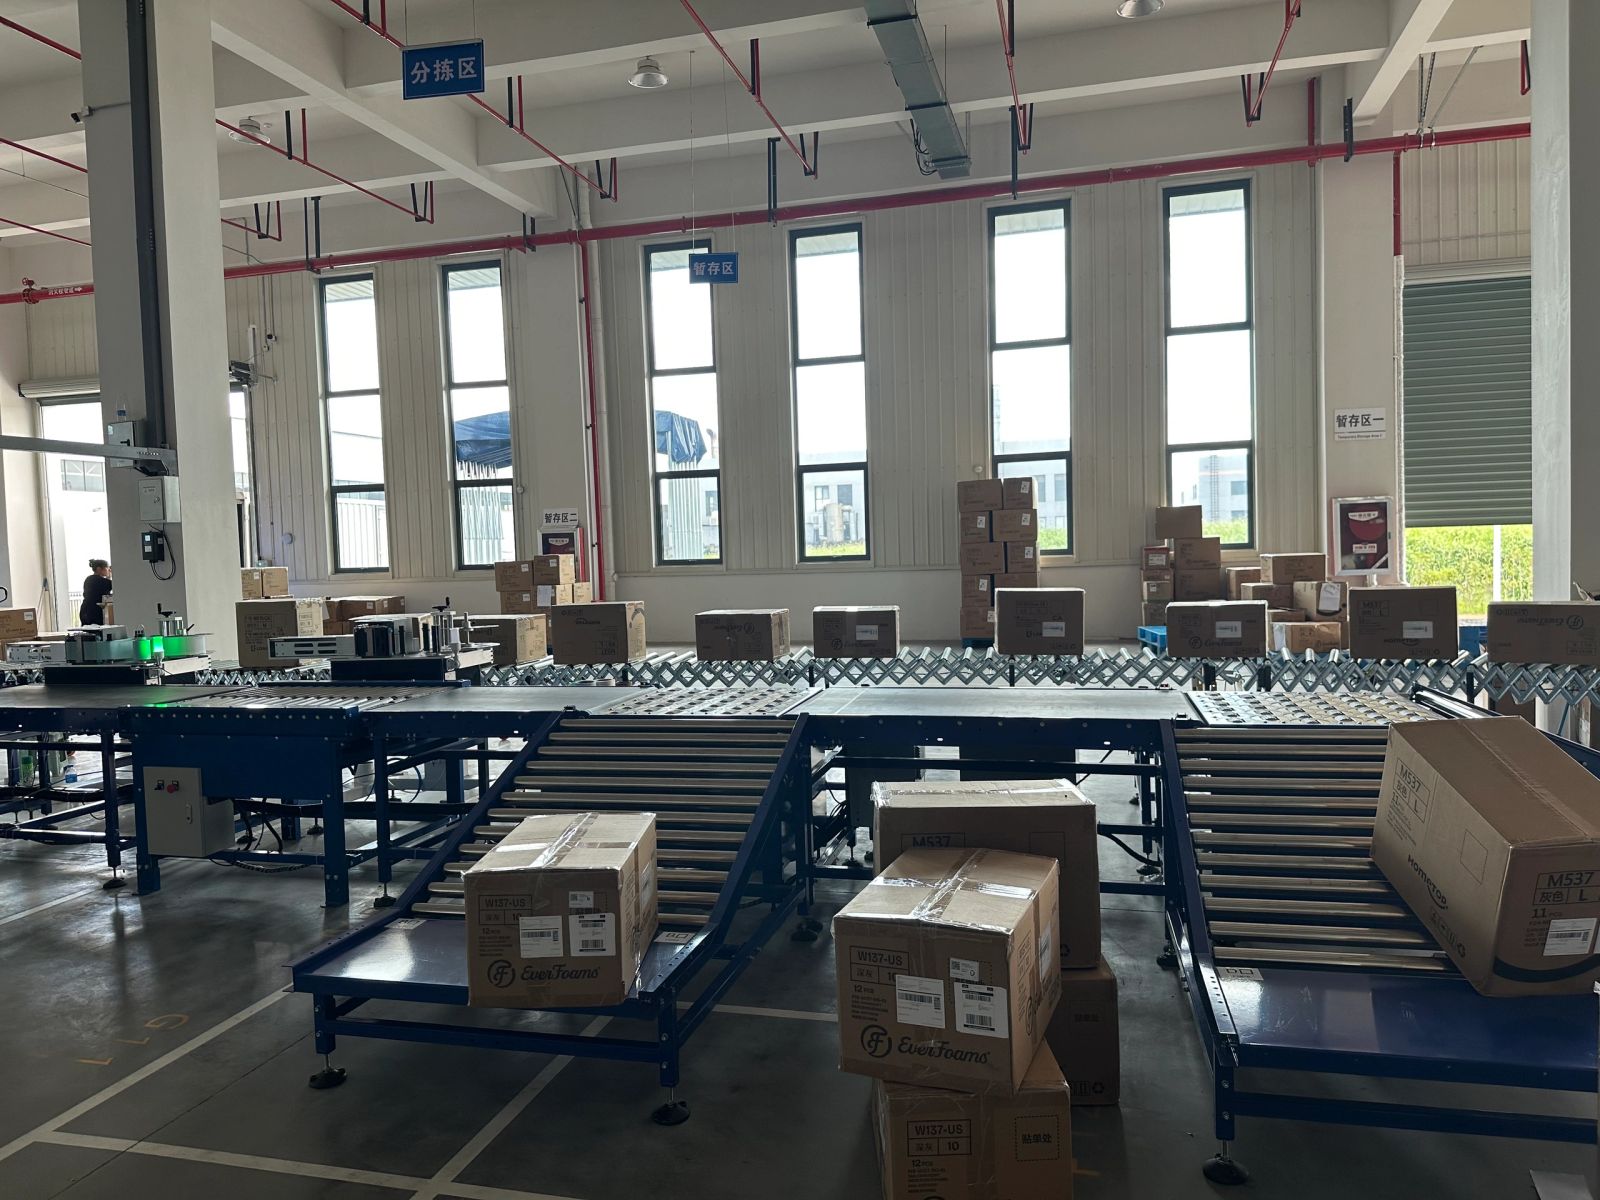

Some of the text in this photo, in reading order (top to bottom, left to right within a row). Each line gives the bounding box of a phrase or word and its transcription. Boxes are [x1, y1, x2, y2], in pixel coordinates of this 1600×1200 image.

[410, 56, 477, 84] 分拣区
[693, 261, 734, 276] 暂存区
[1336, 413, 1384, 428] 暂存区一
[544, 512, 578, 524] 暂存区二
[1399, 764, 1421, 793] M537
[912, 835, 951, 848] M537
[1547, 871, 1594, 887] M537
[1539, 890, 1563, 903] 灰色
[1579, 889, 1588, 902] L
[485, 897, 526, 908] W137-US
[1531, 907, 1547, 919] 11
[858, 951, 903, 966] W137-US
[520, 963, 600, 981] EverFoams
[854, 983, 863, 993] 12
[897, 1036, 990, 1064] EverFoams
[914, 1123, 964, 1136] W137-US
[947, 1141, 960, 1152] 10
[911, 1159, 920, 1168] 12
